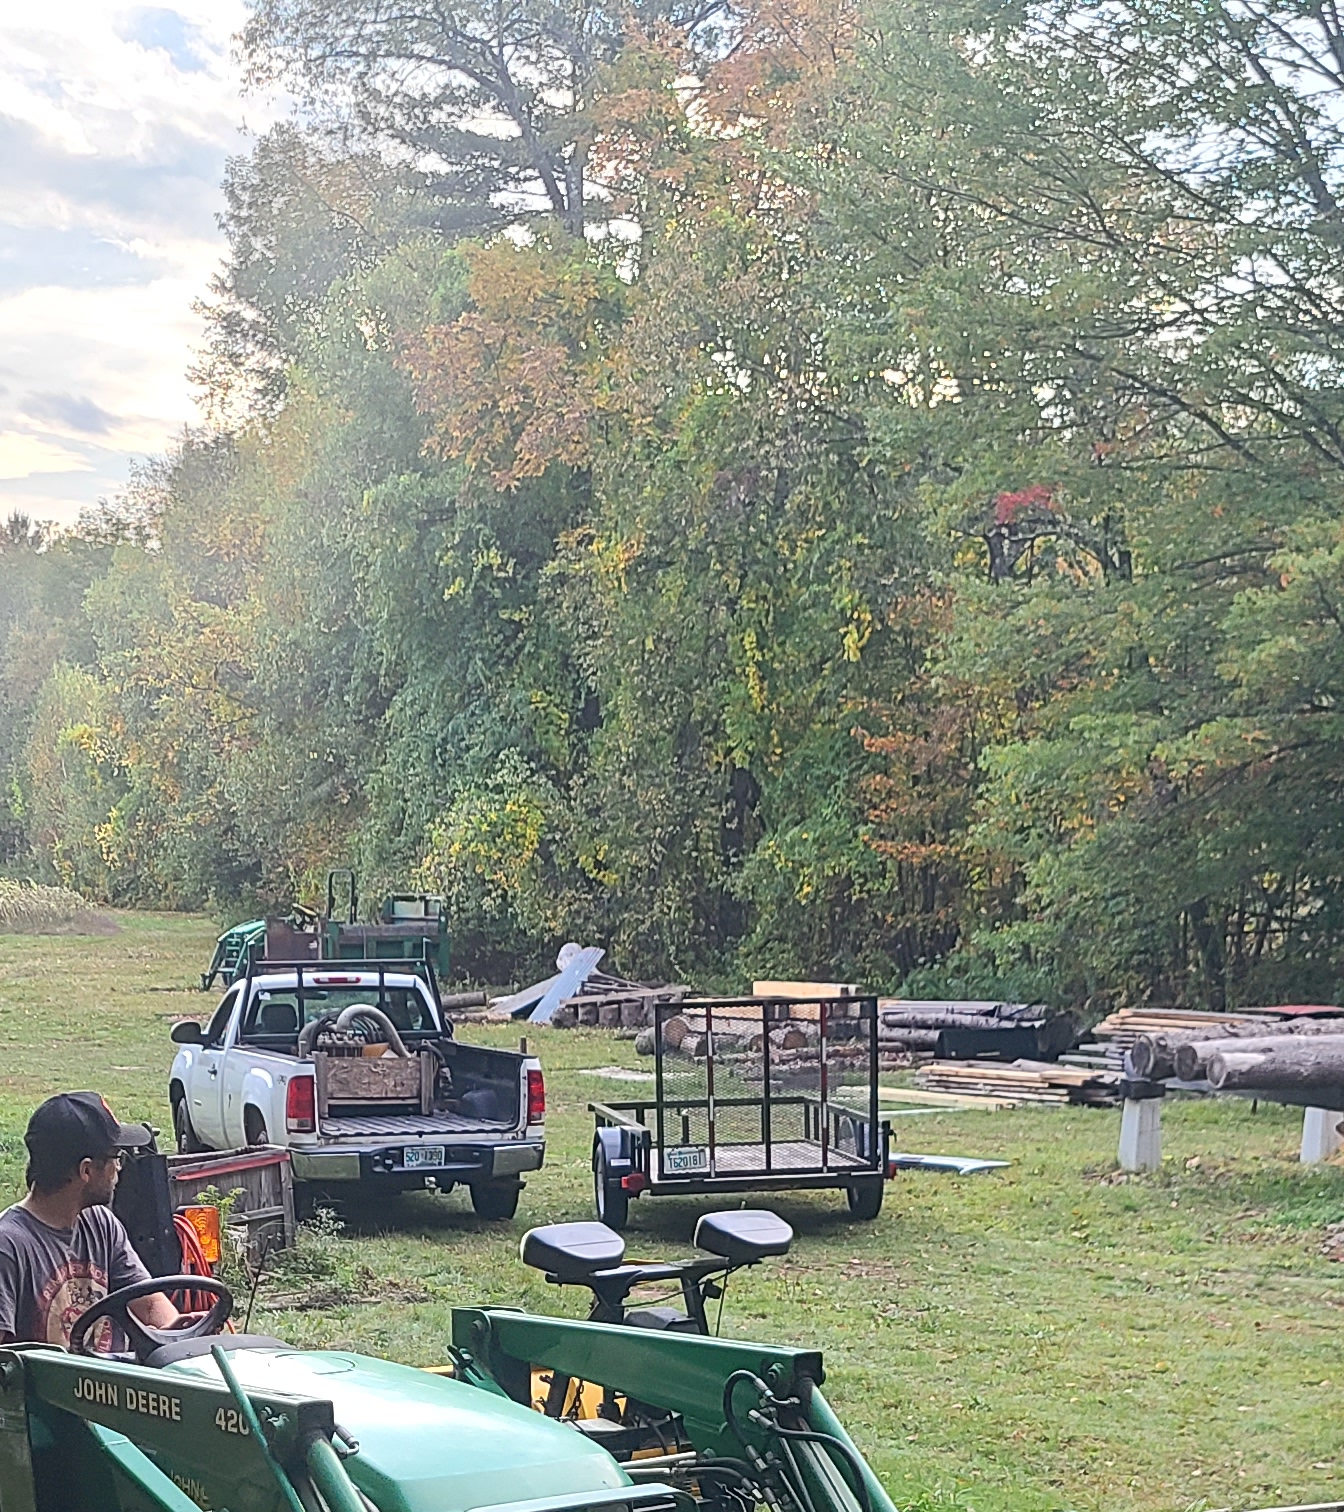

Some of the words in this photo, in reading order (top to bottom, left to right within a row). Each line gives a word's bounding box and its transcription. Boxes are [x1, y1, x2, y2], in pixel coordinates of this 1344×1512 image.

[669, 1154, 701, 1169] T620181
[73, 1376, 118, 1407] JOHN
[126, 1387, 182, 1421] DEERE
[215, 1406, 250, 1436] 420
